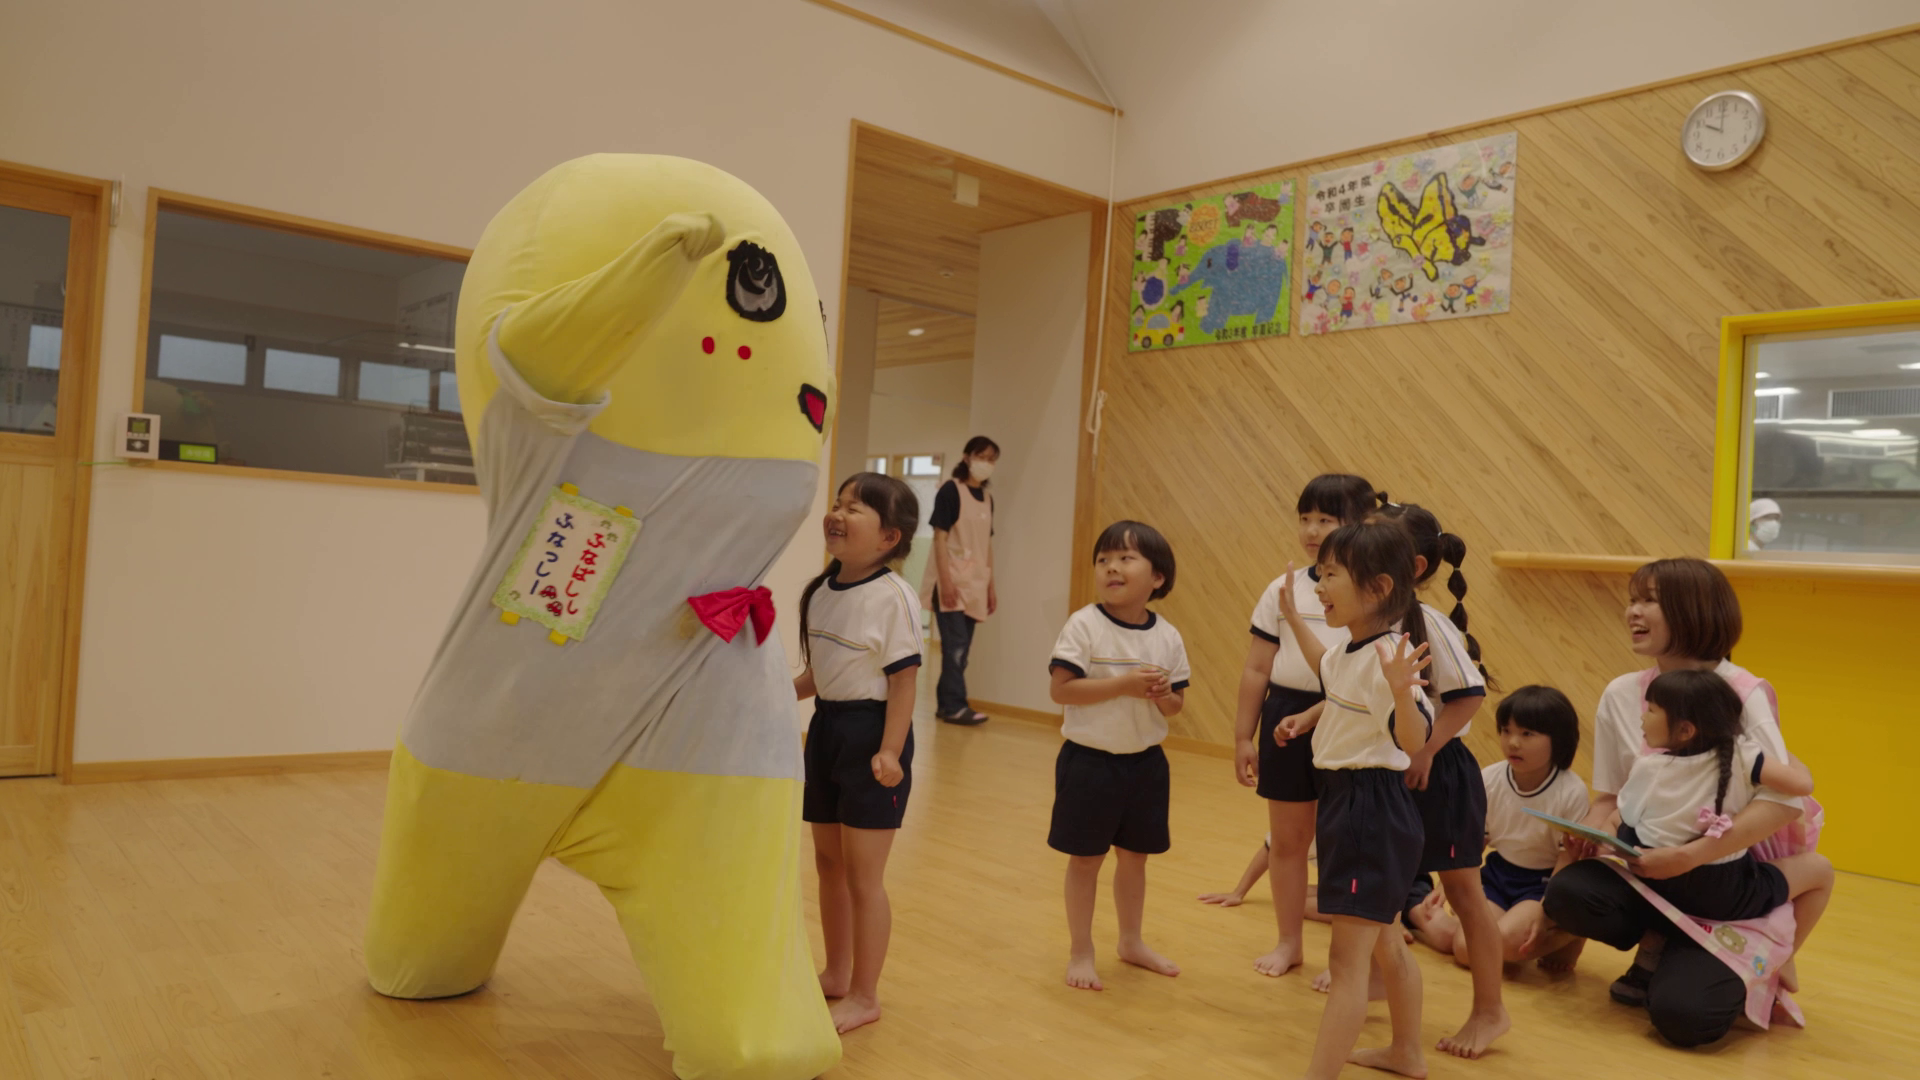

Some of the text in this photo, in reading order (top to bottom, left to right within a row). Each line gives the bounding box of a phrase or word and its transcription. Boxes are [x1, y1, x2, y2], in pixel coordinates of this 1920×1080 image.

[1316, 175, 1372, 202] 令和4年度
[529, 512, 575, 595] ふなっしー
[565, 533, 607, 615] ふなばしし
